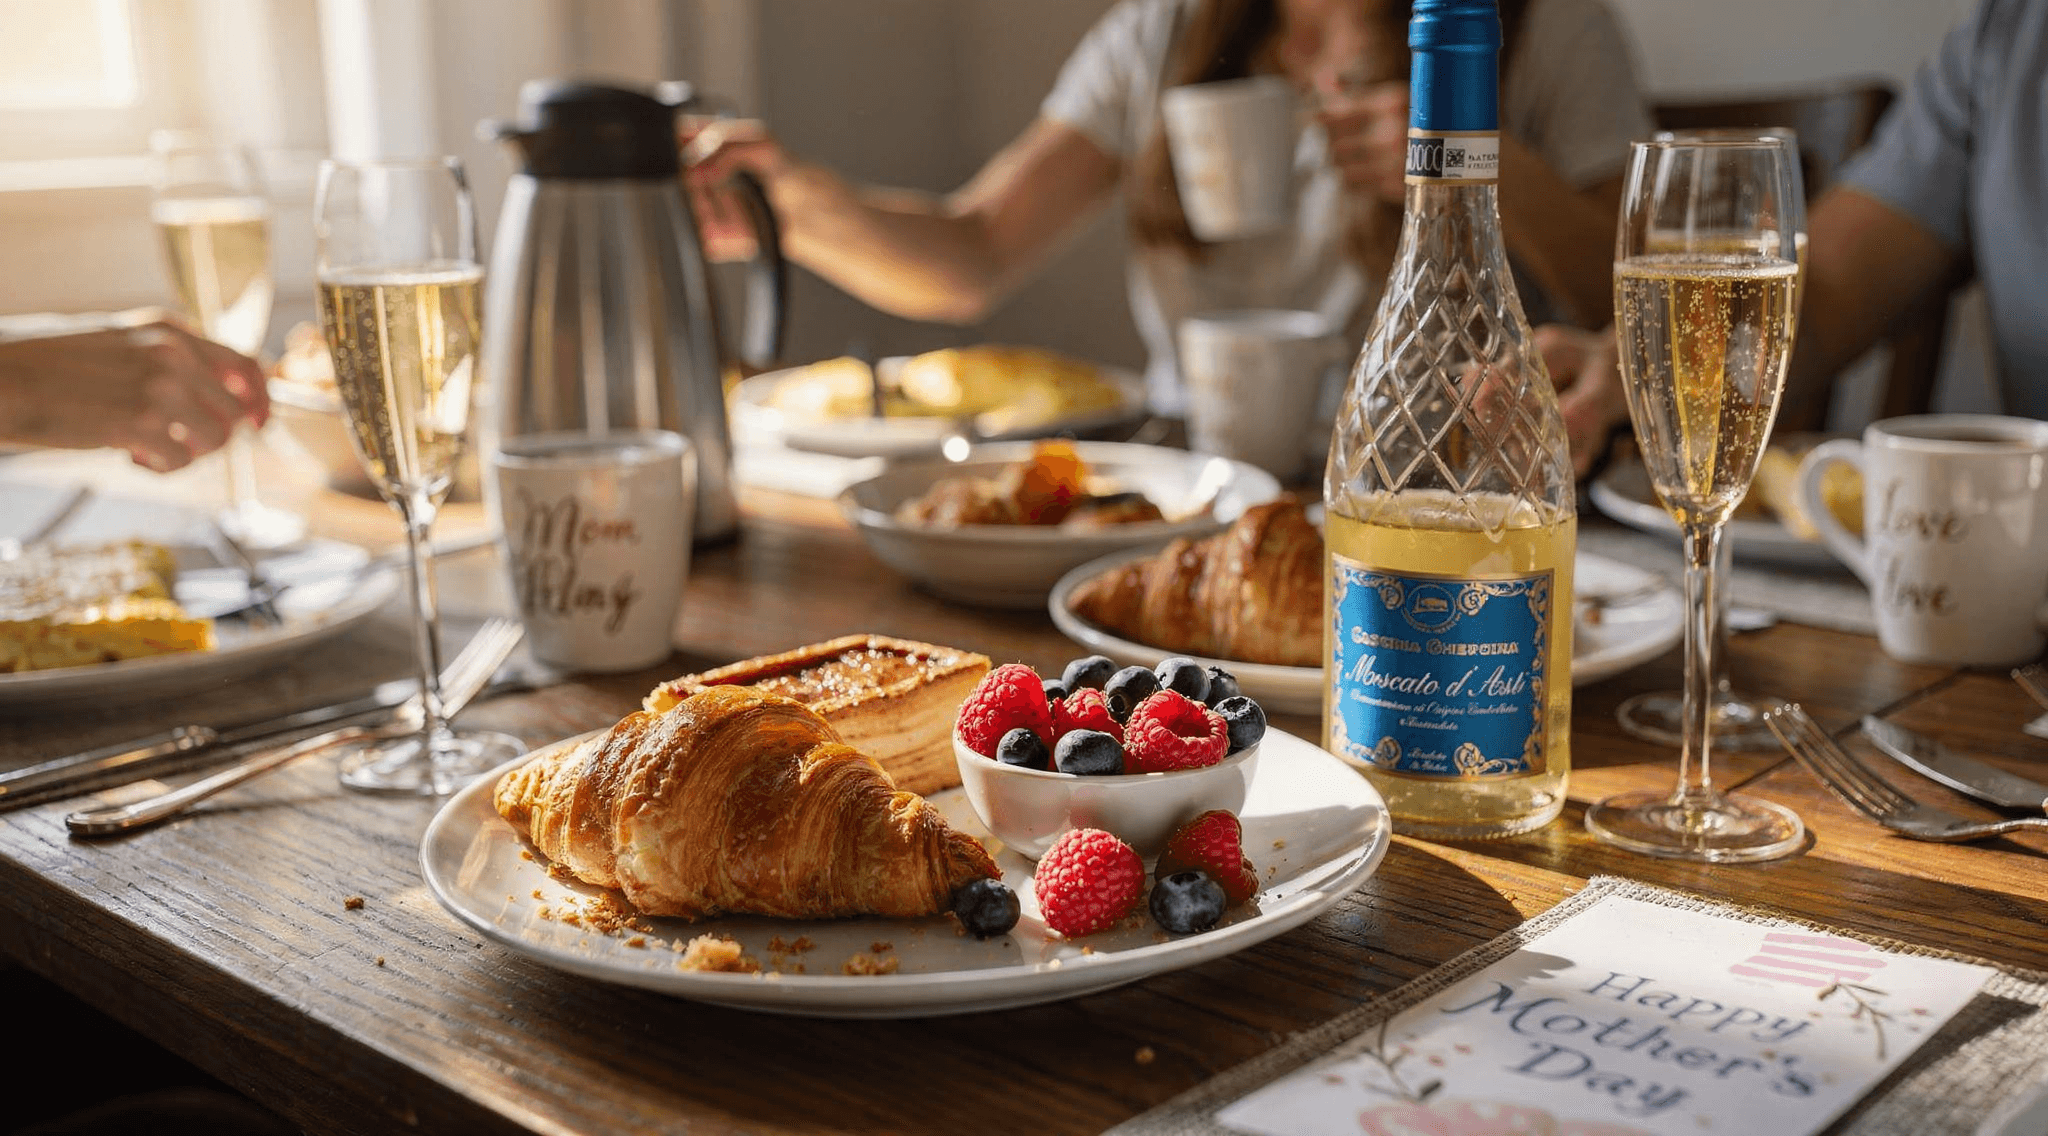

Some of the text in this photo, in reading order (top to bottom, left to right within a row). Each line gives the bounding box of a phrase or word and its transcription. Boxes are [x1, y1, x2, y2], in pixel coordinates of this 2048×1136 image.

[516, 487, 642, 553] Mom
[1439, 981, 1815, 1098] Mother's
[1584, 971, 1814, 1042] Happy
[1505, 1041, 1689, 1118] Day
